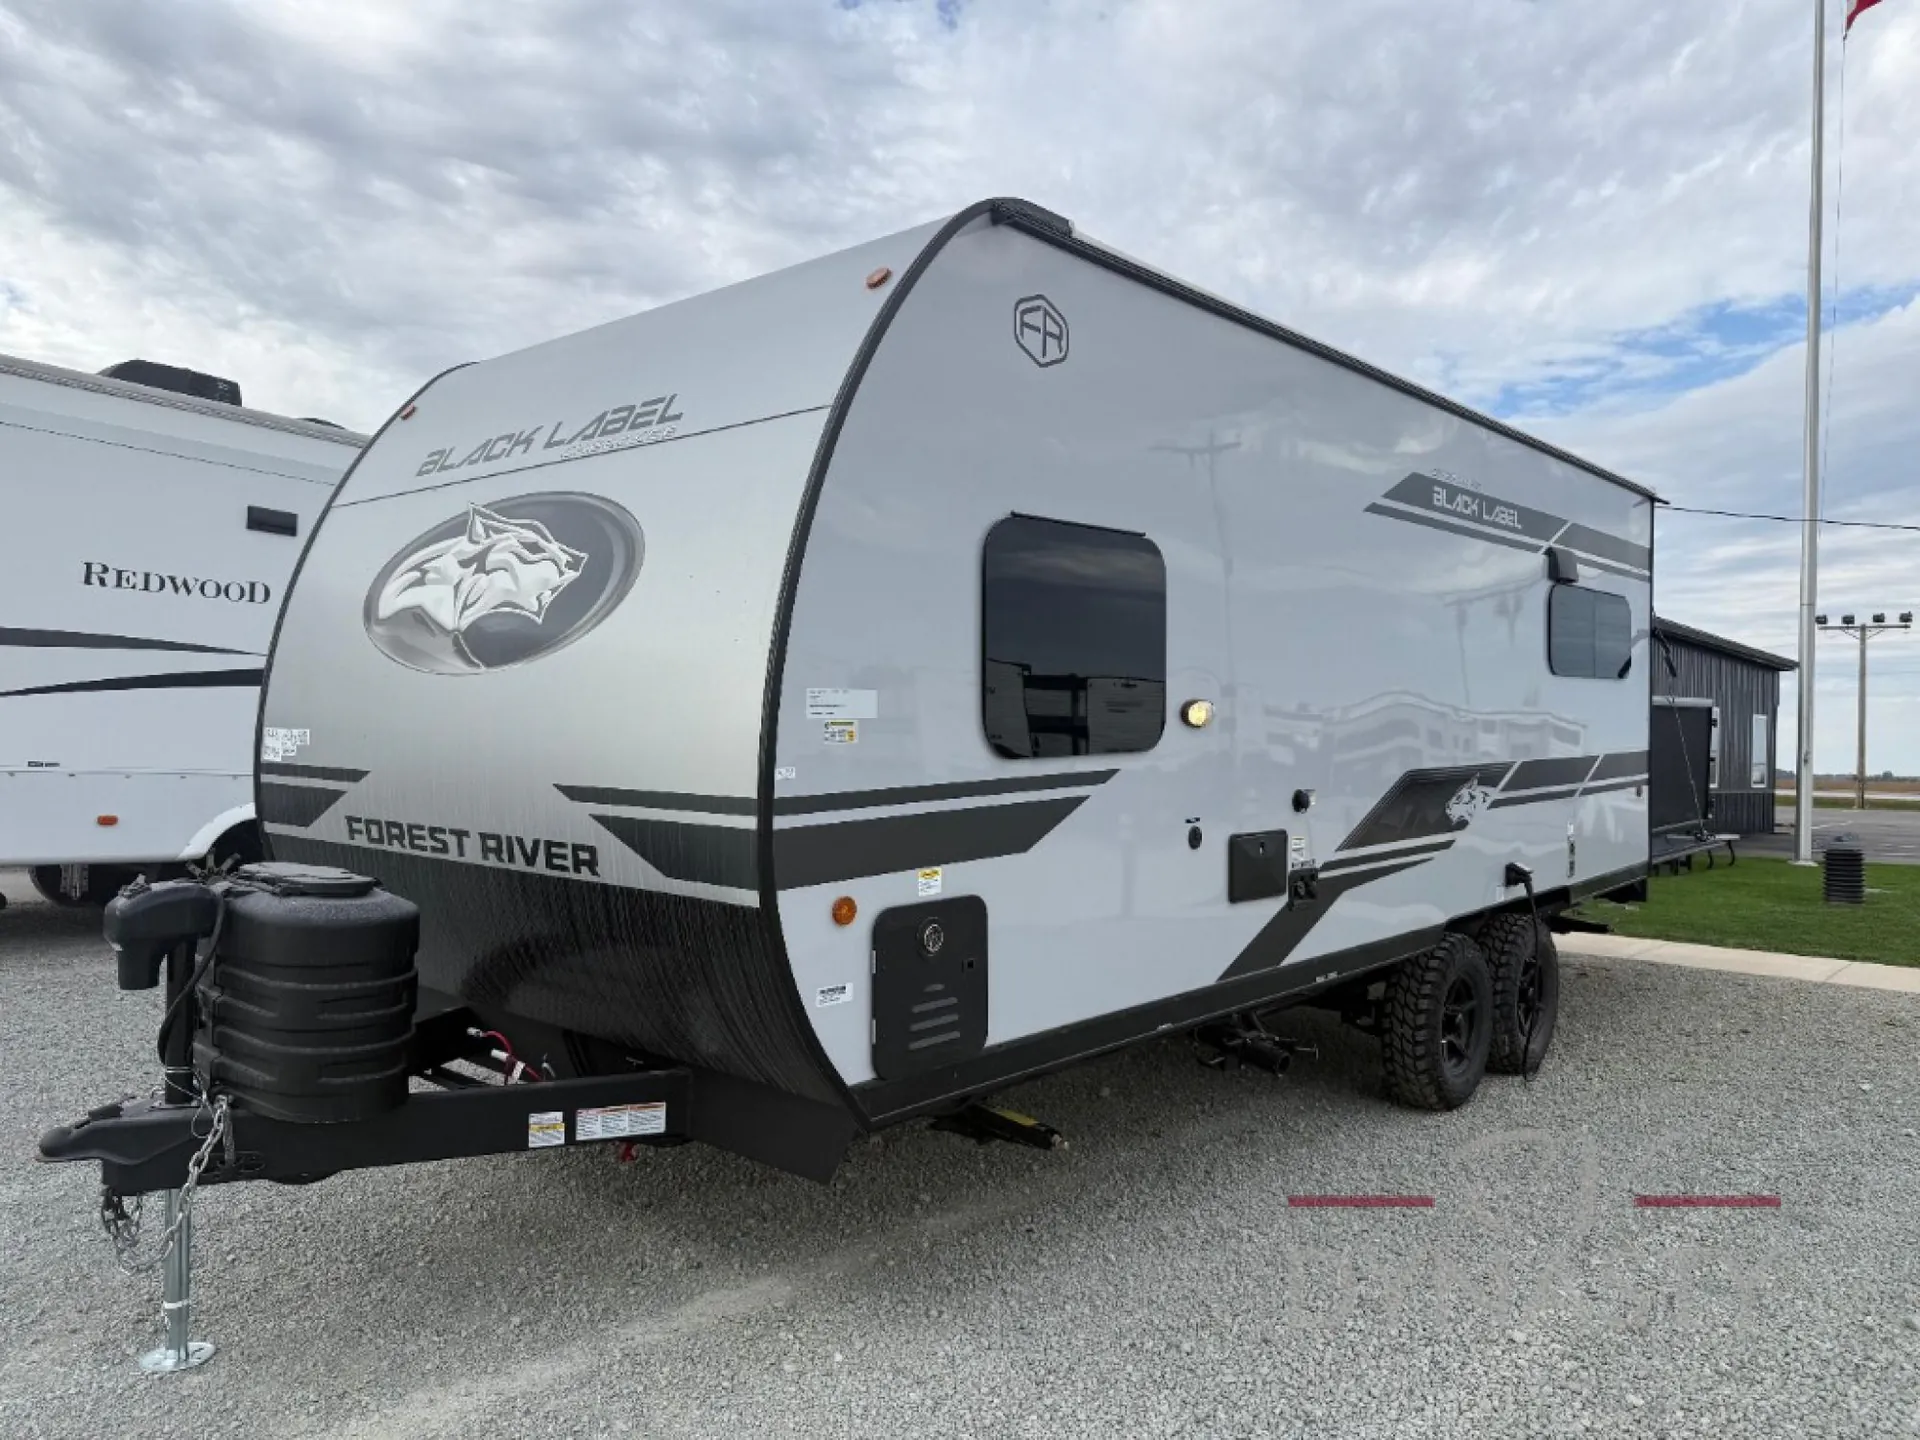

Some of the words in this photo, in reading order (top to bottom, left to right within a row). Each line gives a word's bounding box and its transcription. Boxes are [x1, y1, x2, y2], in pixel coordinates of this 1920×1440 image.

[415, 424, 544, 477] BLACK
[543, 392, 684, 449] LABEL
[1432, 485, 1480, 517] BLACK
[1482, 499, 1523, 530] LABEL
[82, 560, 271, 604] REDWOOD
[344, 815, 471, 857] FOREST
[478, 832, 600, 877] RIVER
